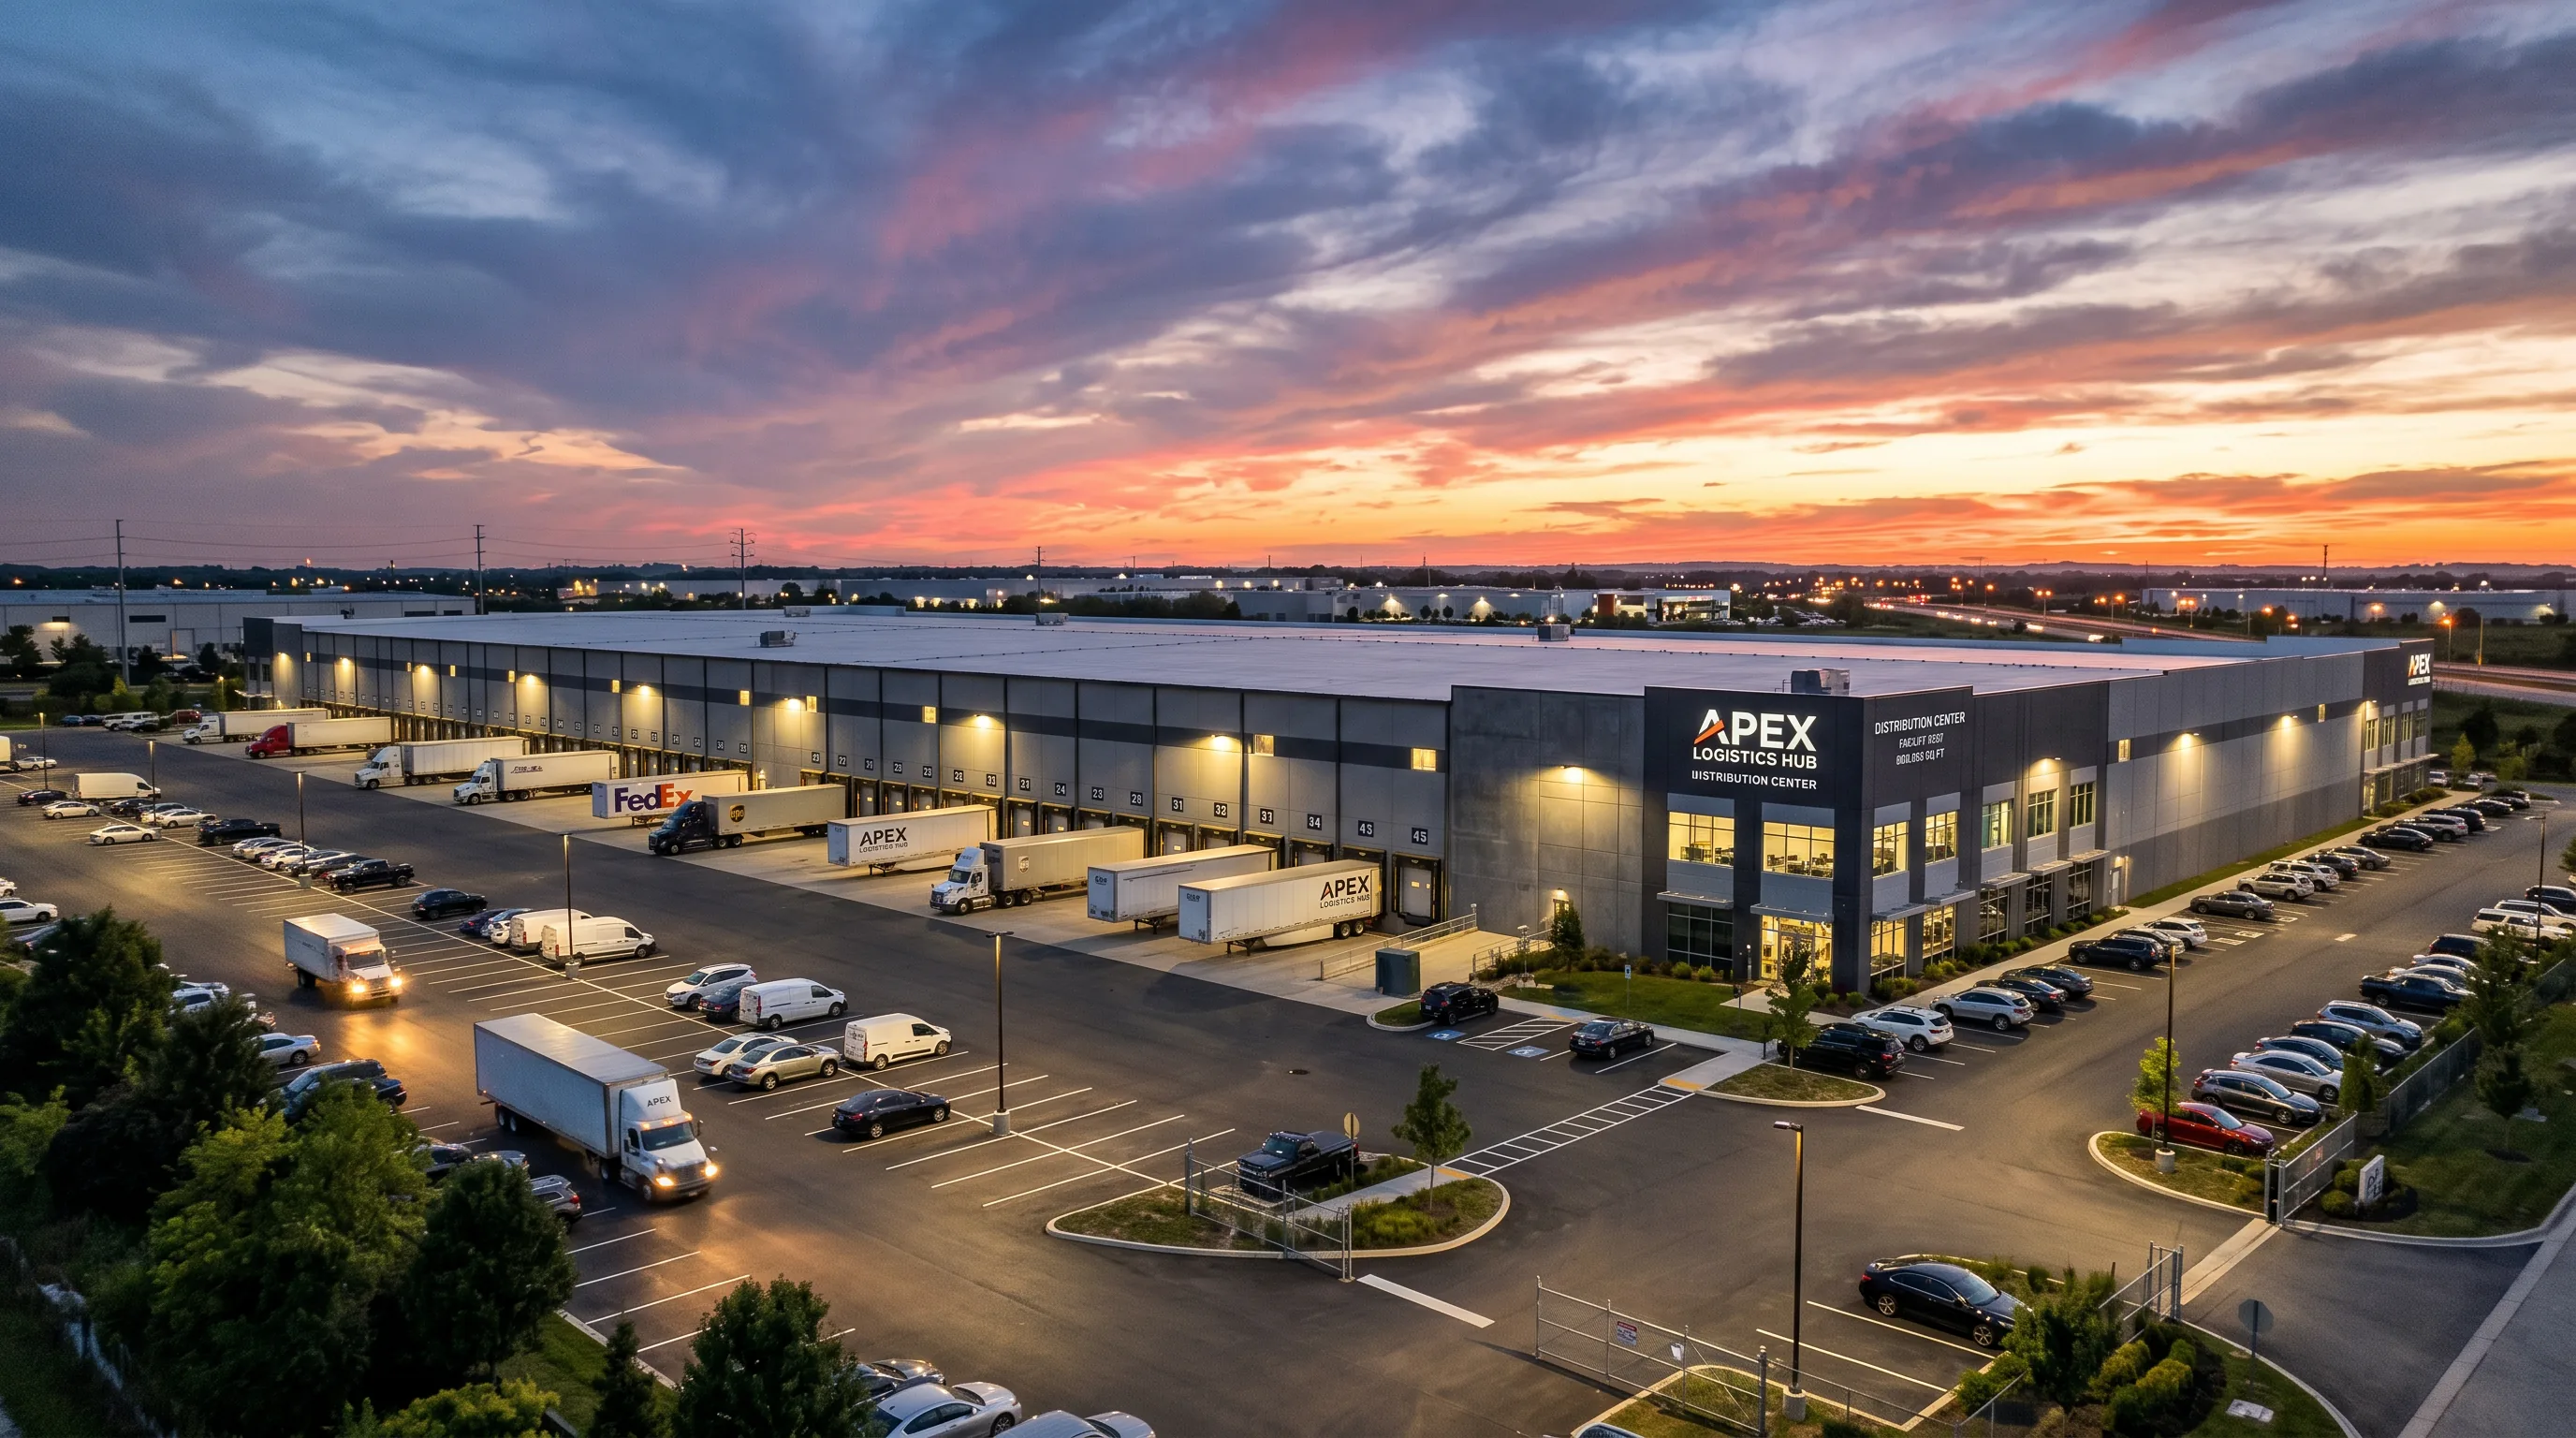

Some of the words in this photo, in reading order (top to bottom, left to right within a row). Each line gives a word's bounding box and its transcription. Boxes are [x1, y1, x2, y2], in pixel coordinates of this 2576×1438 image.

[2408, 653, 2430, 677] APEX
[1875, 717, 1932, 735] DISTRIBUTION
[1934, 712, 1966, 726] CENTER
[1693, 709, 1817, 752] APEX
[1692, 746, 1778, 766] LOGISTICS
[1782, 753, 1817, 770] HUB
[1936, 748, 1945, 758] FT
[1056, 785, 1065, 794] 24
[1771, 776, 1817, 790] CENTER
[614, 783, 694, 813] FedEx
[1092, 788, 1103, 799] 23
[1132, 793, 1142, 803] 28
[1173, 799, 1183, 810] 31
[1215, 804, 1227, 815] 32
[1309, 816, 1321, 829] 34
[859, 827, 907, 847] APEX
[1412, 830, 1427, 843] 45
[1320, 874, 1369, 901] APEX
[1320, 896, 1355, 909] LOGISTICS
[647, 1095, 671, 1107] APEX
